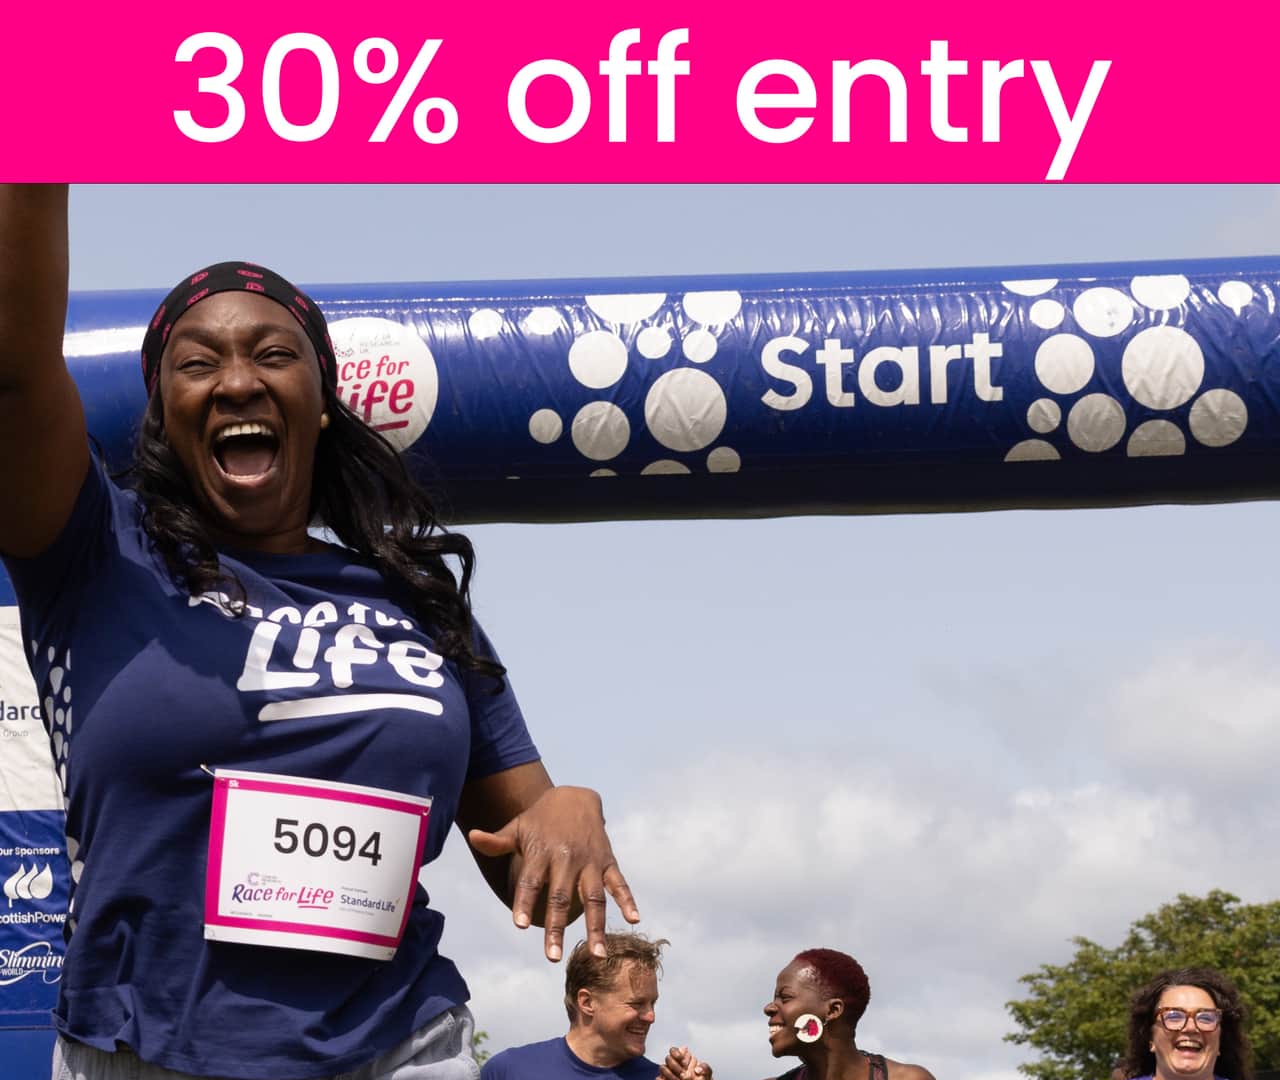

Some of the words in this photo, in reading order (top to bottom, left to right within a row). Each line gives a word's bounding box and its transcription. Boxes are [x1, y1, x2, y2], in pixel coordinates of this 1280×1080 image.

[336, 359, 371, 381] ce
[376, 355, 410, 376] for
[761, 332, 1003, 411] Start
[237, 621, 444, 692] Life
[14, 847, 60, 857] Sponsors
[274, 818, 382, 866] 5094
[232, 883, 273, 903] Race
[275, 887, 297, 901] for
[297, 886, 335, 904] Life
[340, 894, 381, 910] Standard
[381, 901, 396, 912] Life
[1, 968, 24, 976] WORLD
